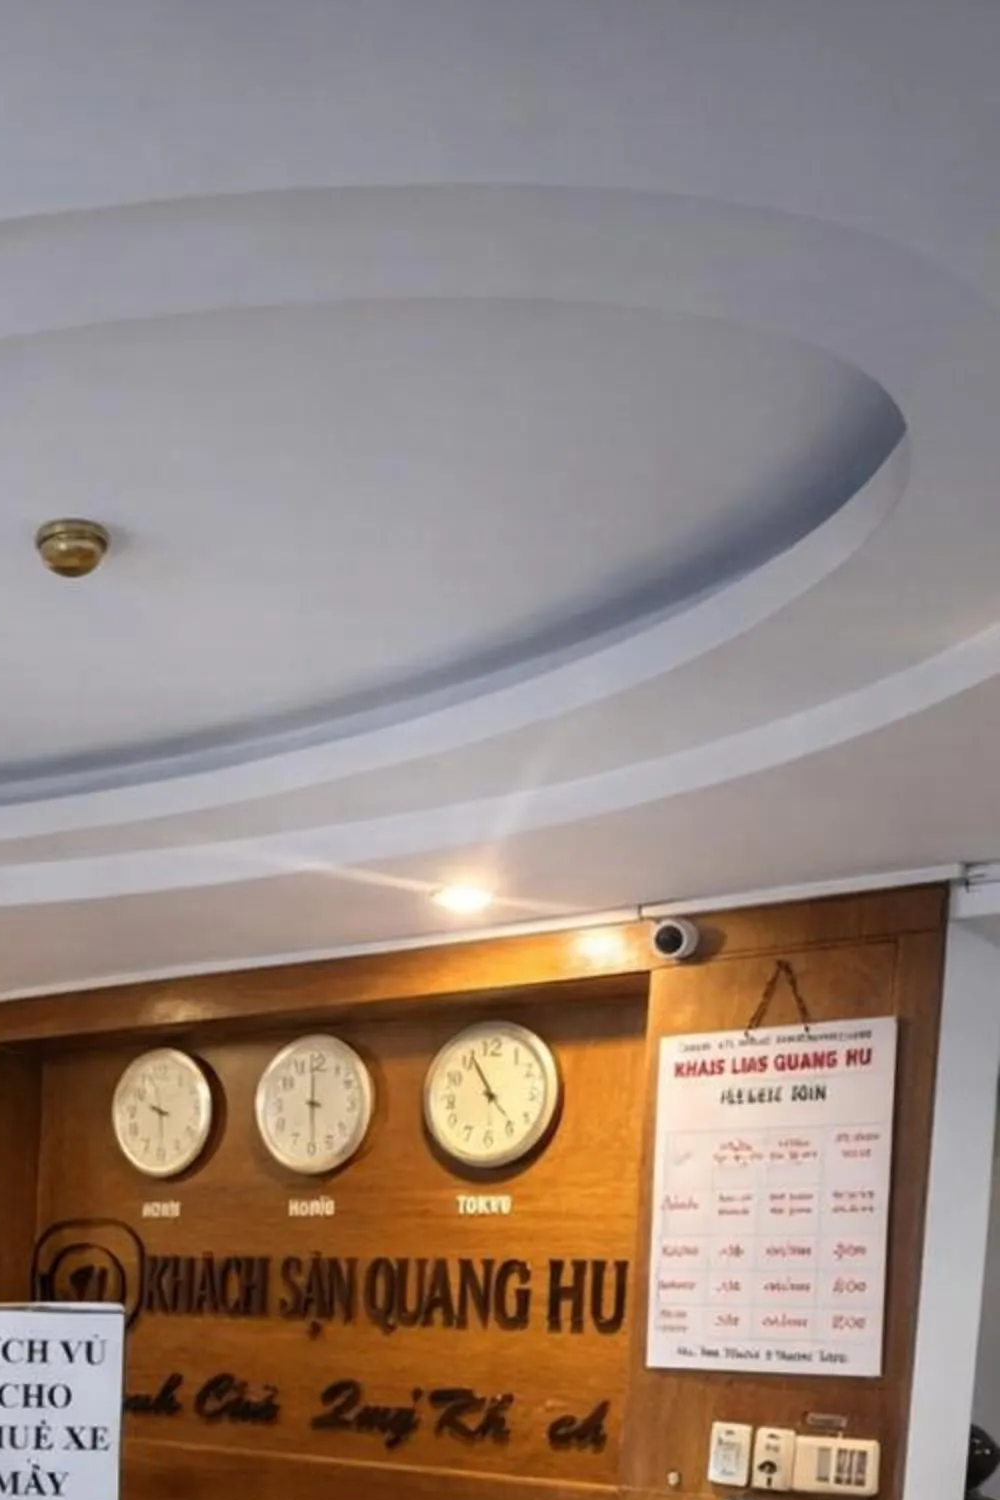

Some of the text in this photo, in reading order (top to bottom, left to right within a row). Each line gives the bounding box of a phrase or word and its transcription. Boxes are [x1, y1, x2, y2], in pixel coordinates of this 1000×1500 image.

[482, 1037, 502, 1057] 12
[364, 1257, 532, 1335] QUANG
[547, 1259, 629, 1334] HU
[63, 1425, 111, 1451] XE
